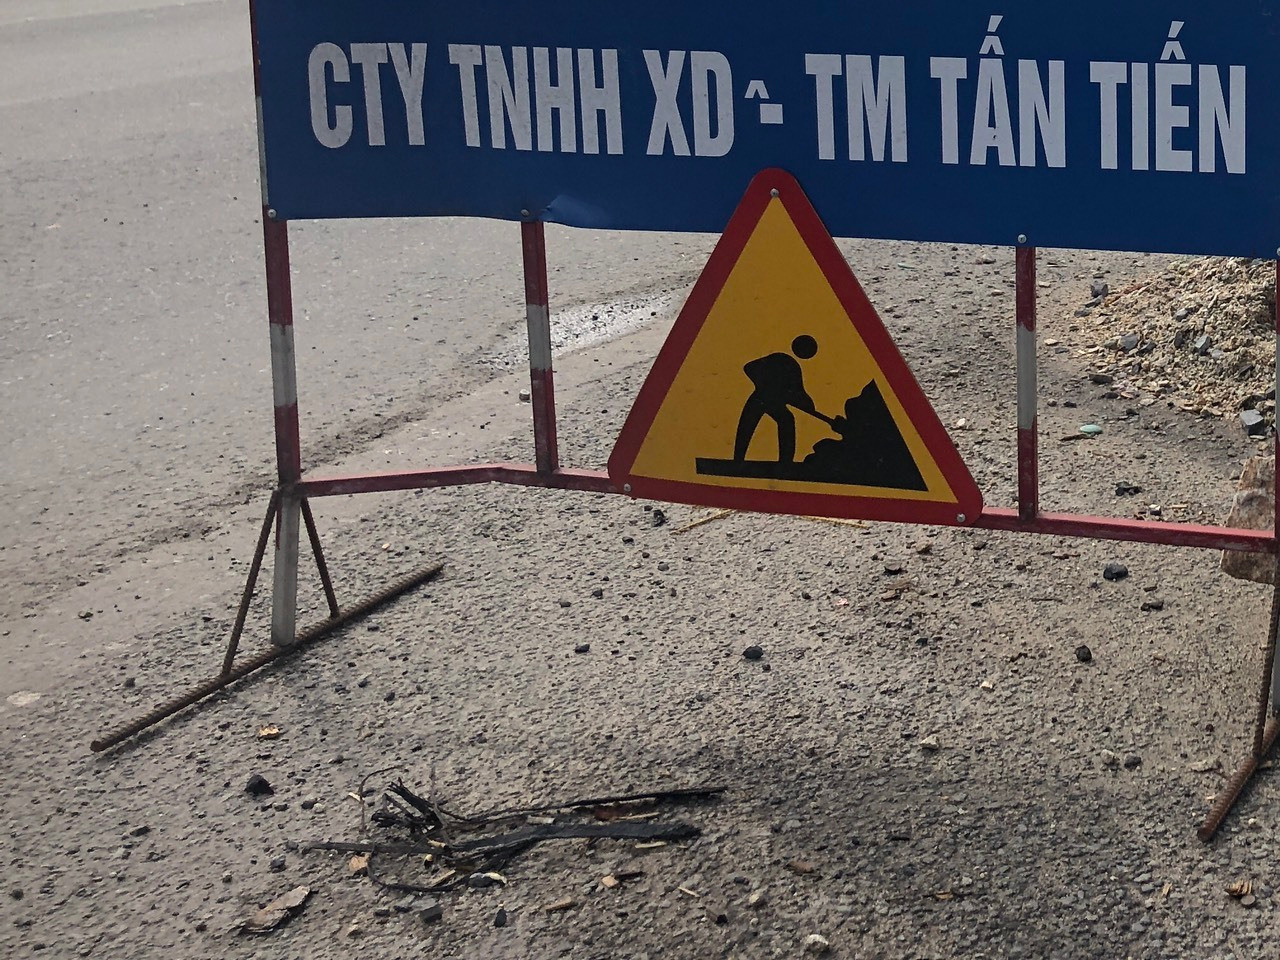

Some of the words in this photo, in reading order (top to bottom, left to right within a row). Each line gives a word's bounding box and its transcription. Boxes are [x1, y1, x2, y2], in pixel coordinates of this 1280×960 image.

[308, 42, 428, 149] CTY
[448, 44, 624, 155] TNHH
[642, 49, 735, 157] XD
[805, 53, 908, 162] TM
[930, 15, 1066, 168] TẤN
[1089, 20, 1246, 174] TIẾN
